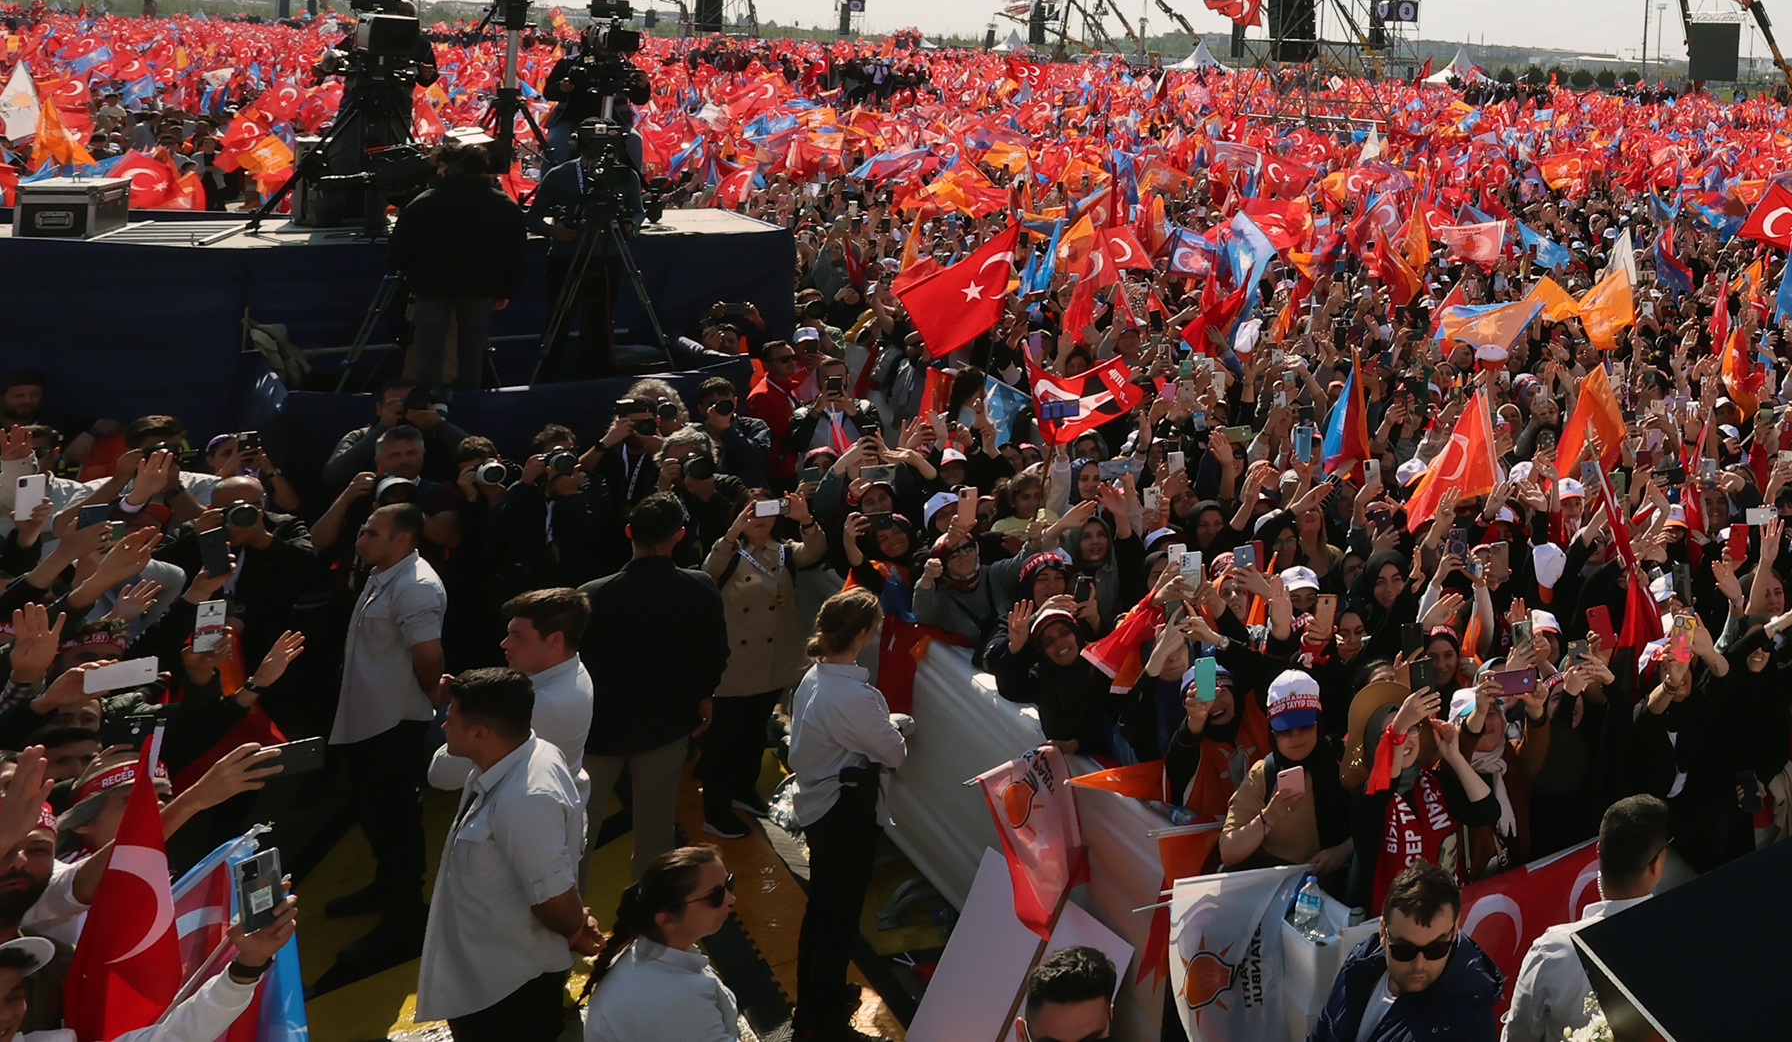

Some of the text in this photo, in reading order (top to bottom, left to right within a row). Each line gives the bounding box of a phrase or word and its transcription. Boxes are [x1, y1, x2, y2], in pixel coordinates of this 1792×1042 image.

[101, 767, 135, 788] RECEP
[1420, 776, 1452, 831] OĞAN
[1404, 829, 1422, 868] CEP
